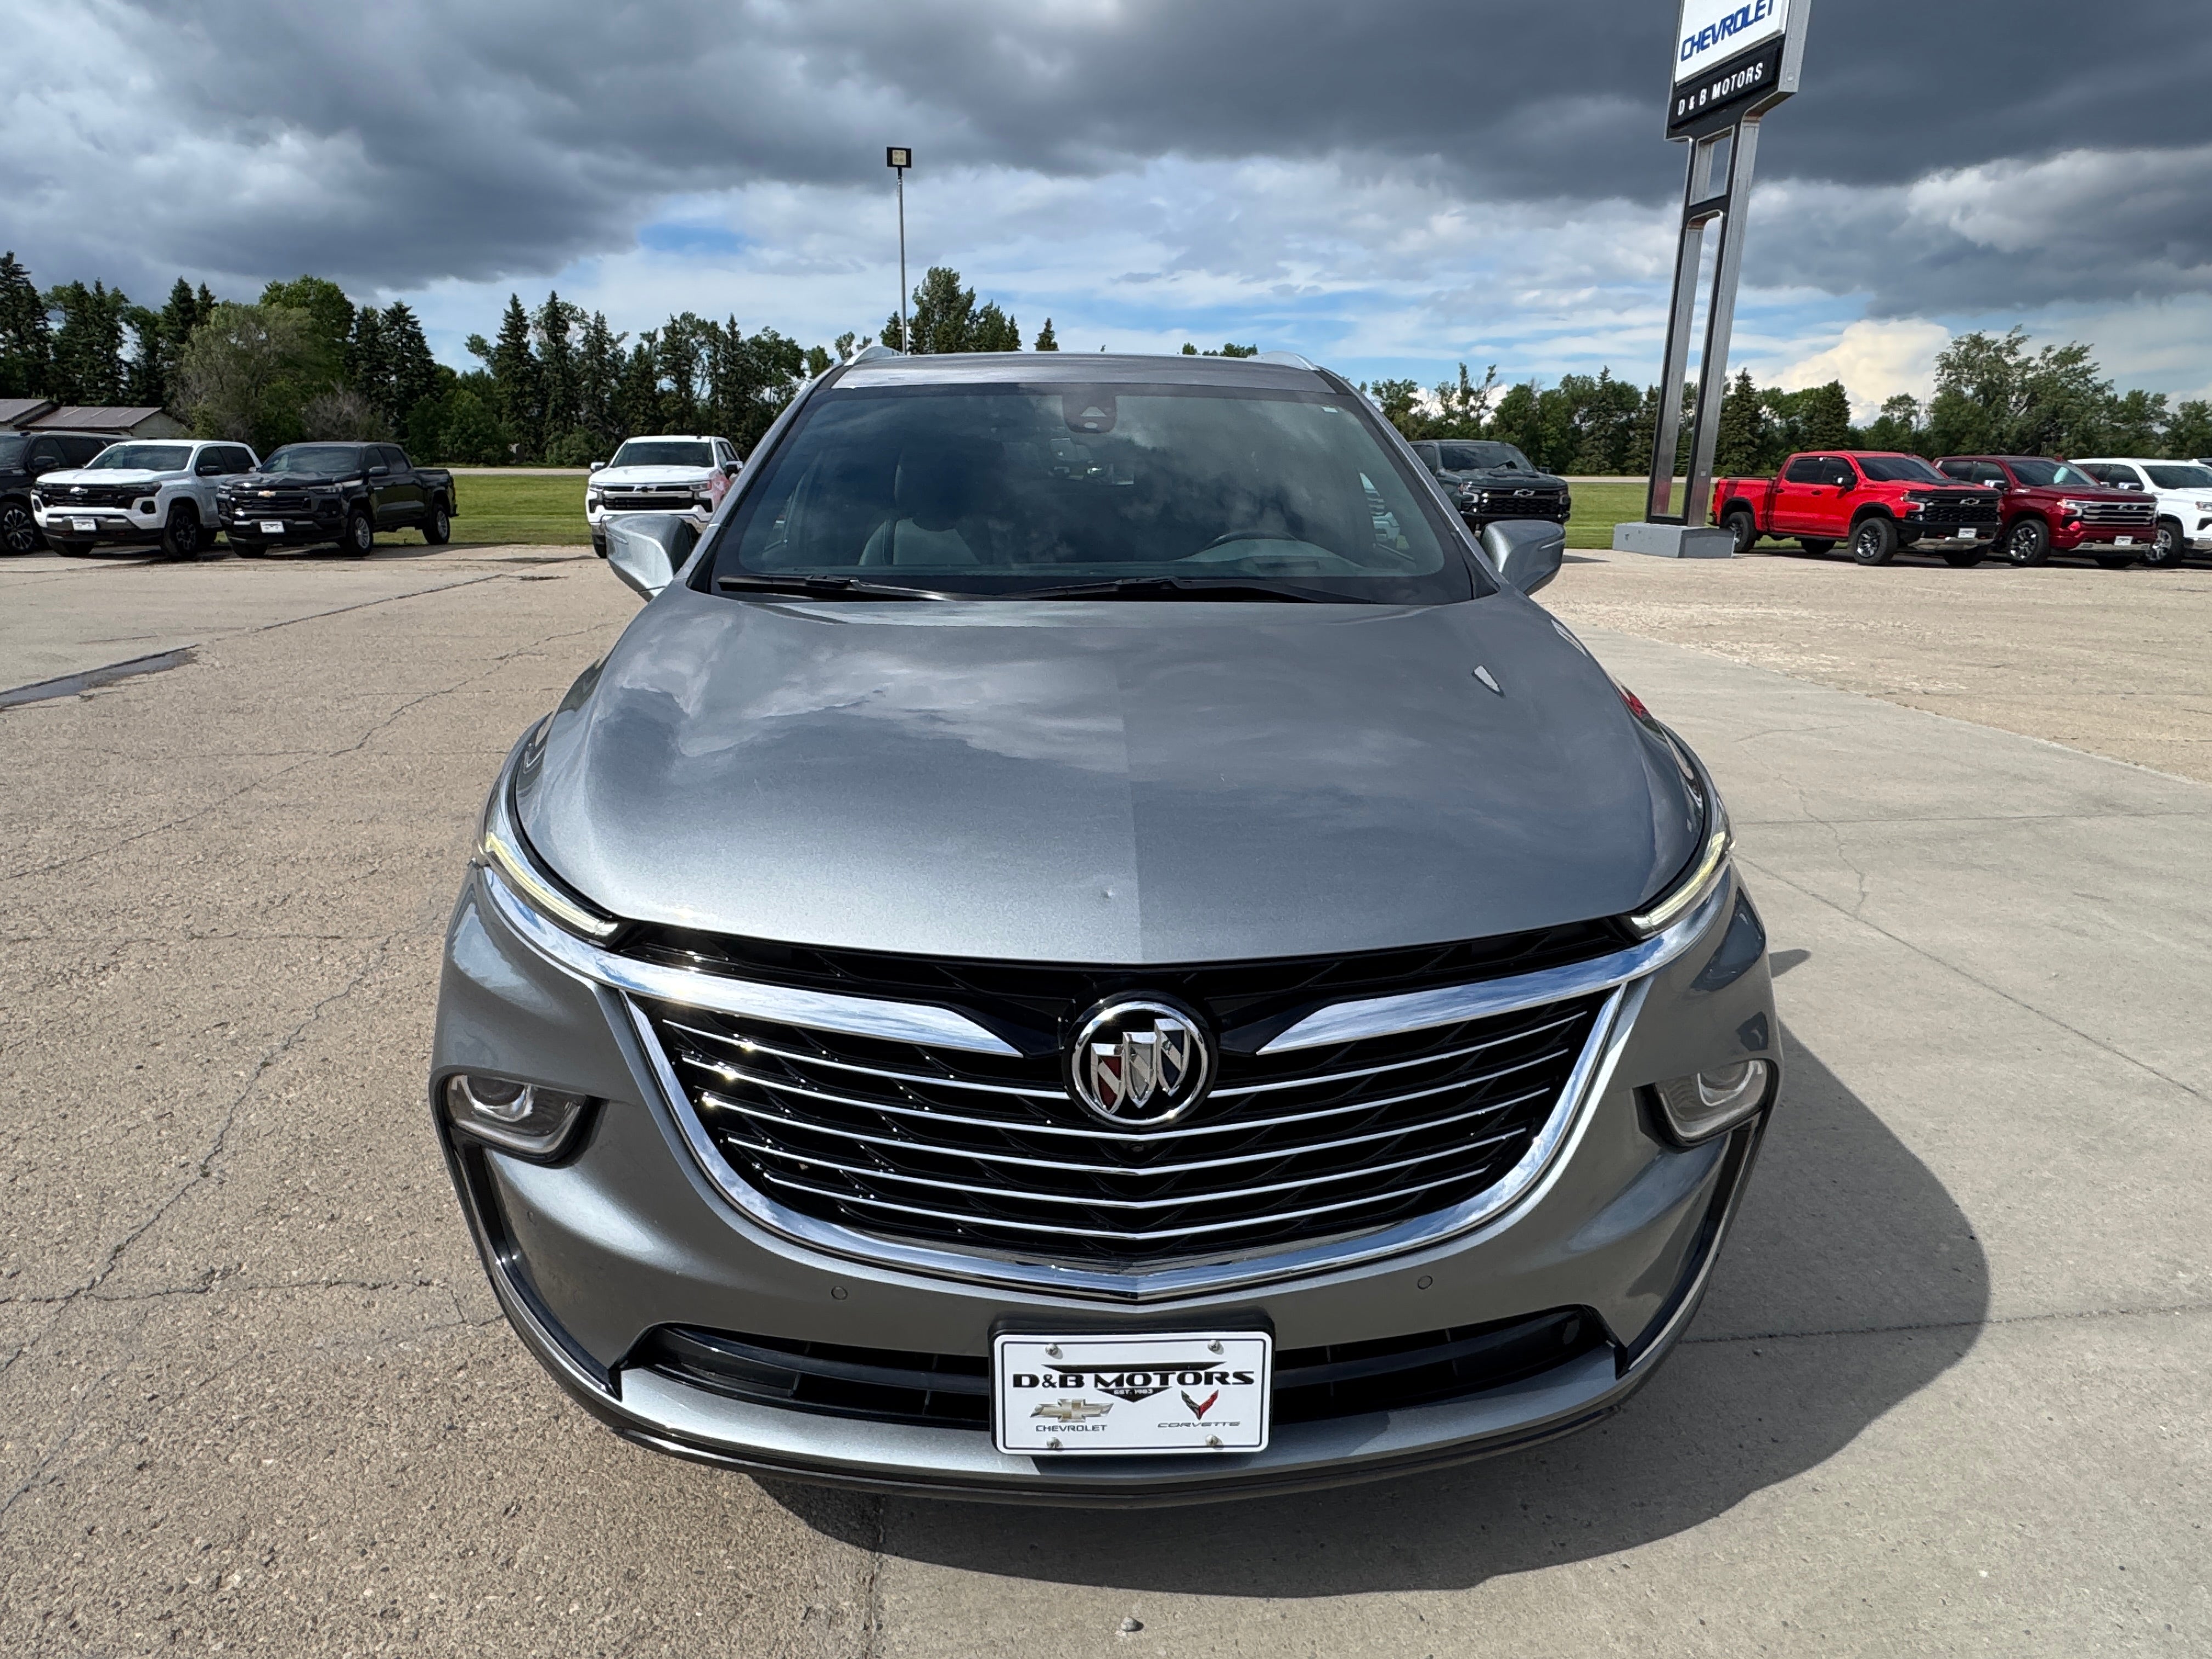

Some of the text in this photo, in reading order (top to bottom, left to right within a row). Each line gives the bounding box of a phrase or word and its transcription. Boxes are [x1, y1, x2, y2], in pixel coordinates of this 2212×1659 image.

[1678, 63, 1763, 116] D & B MOTORS
[1013, 1372, 1254, 1388] D&B MOTORS
